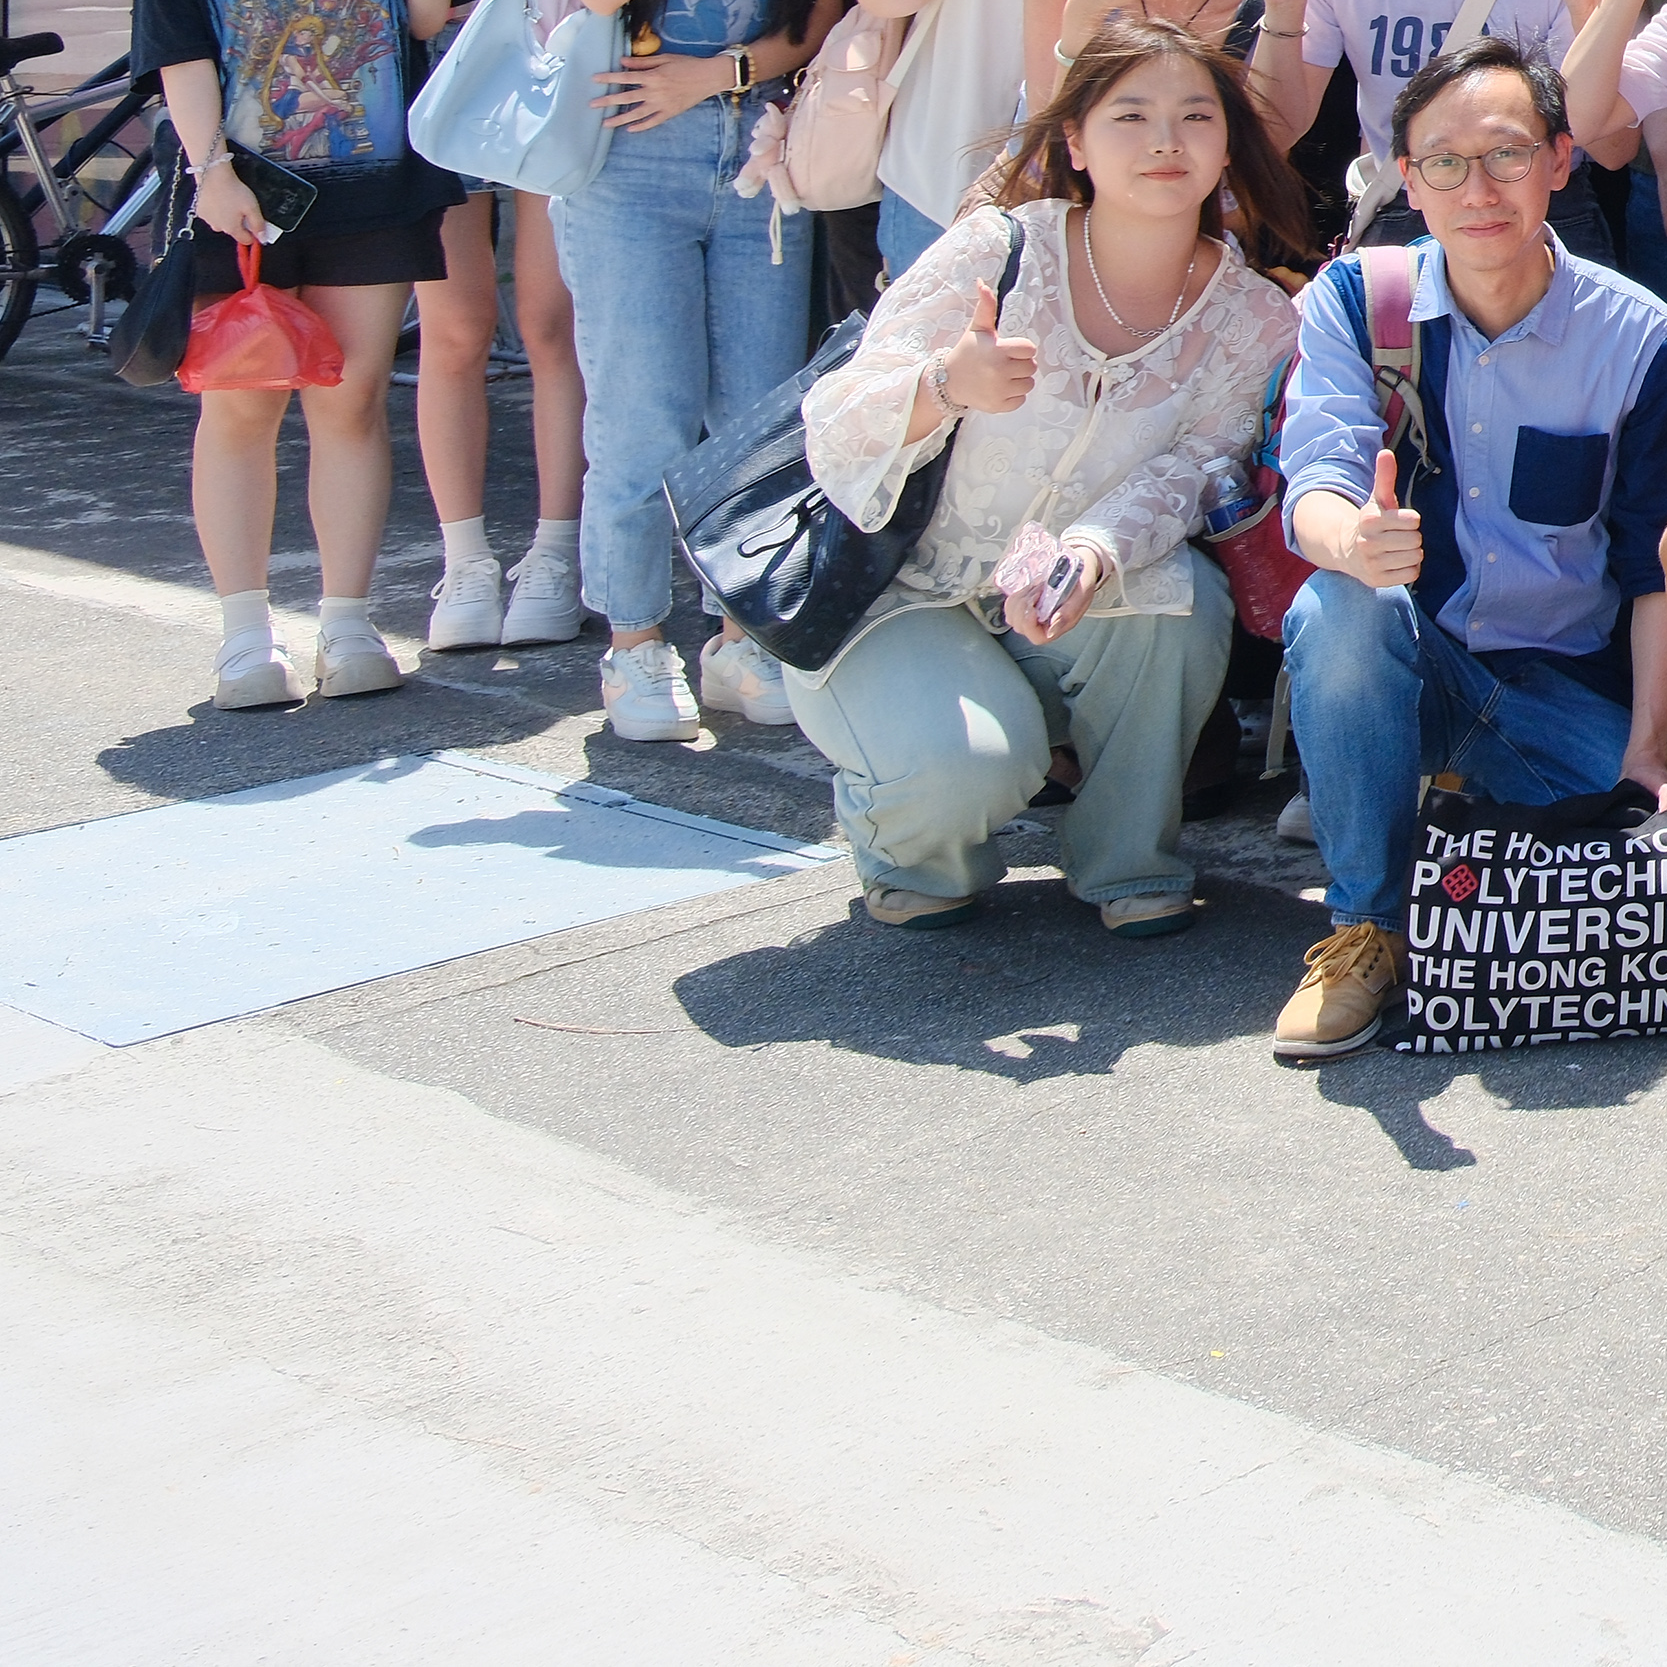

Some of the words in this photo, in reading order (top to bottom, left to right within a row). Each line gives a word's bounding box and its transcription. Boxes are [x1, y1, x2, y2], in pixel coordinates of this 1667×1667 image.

[1426, 824, 1497, 860] THE
[1504, 831, 1611, 868] HONG
[1408, 952, 1477, 990] THE
[1489, 956, 1606, 991] HONG
